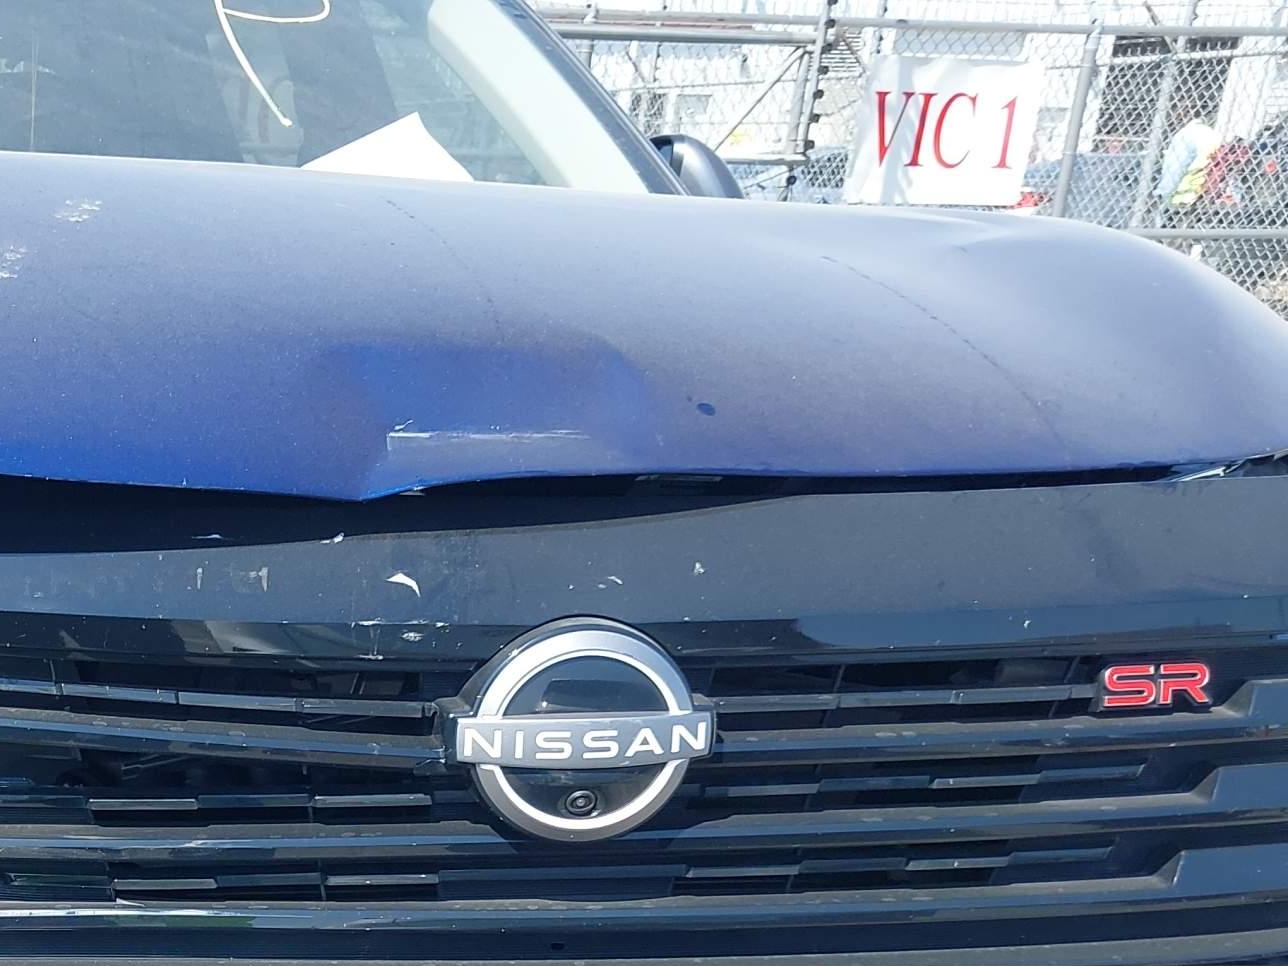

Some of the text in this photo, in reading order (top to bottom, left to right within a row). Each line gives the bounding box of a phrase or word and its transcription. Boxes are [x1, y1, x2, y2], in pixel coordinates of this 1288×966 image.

[875, 91, 1018, 169] VIC 1
[1103, 662, 1211, 707] SR
[463, 721, 707, 760] NISSAN
